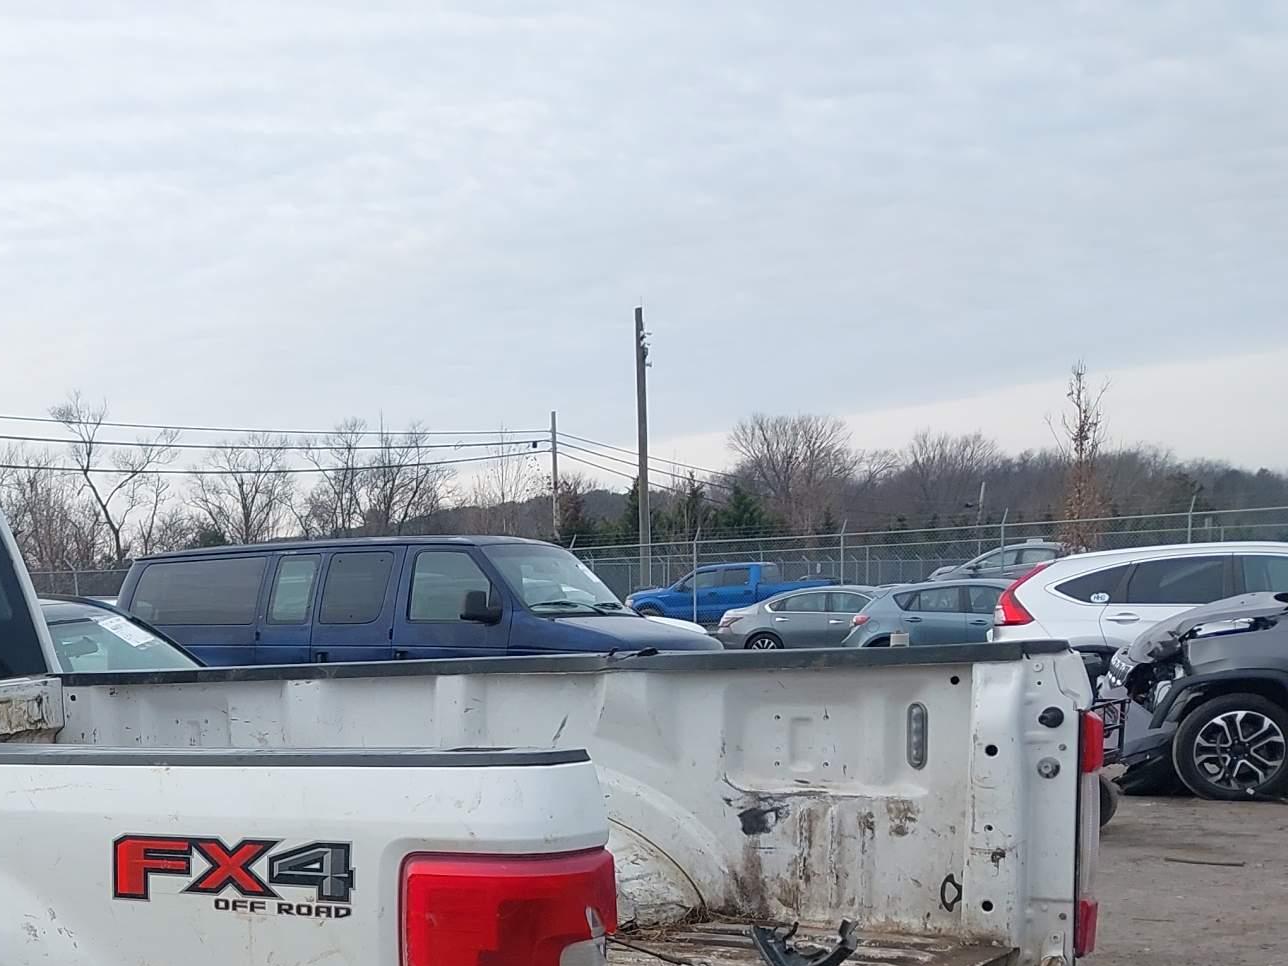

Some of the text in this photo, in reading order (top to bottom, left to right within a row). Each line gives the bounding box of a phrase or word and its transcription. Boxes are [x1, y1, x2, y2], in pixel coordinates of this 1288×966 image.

[113, 834, 355, 903] FX4
[214, 899, 352, 918] OFF ROAD
